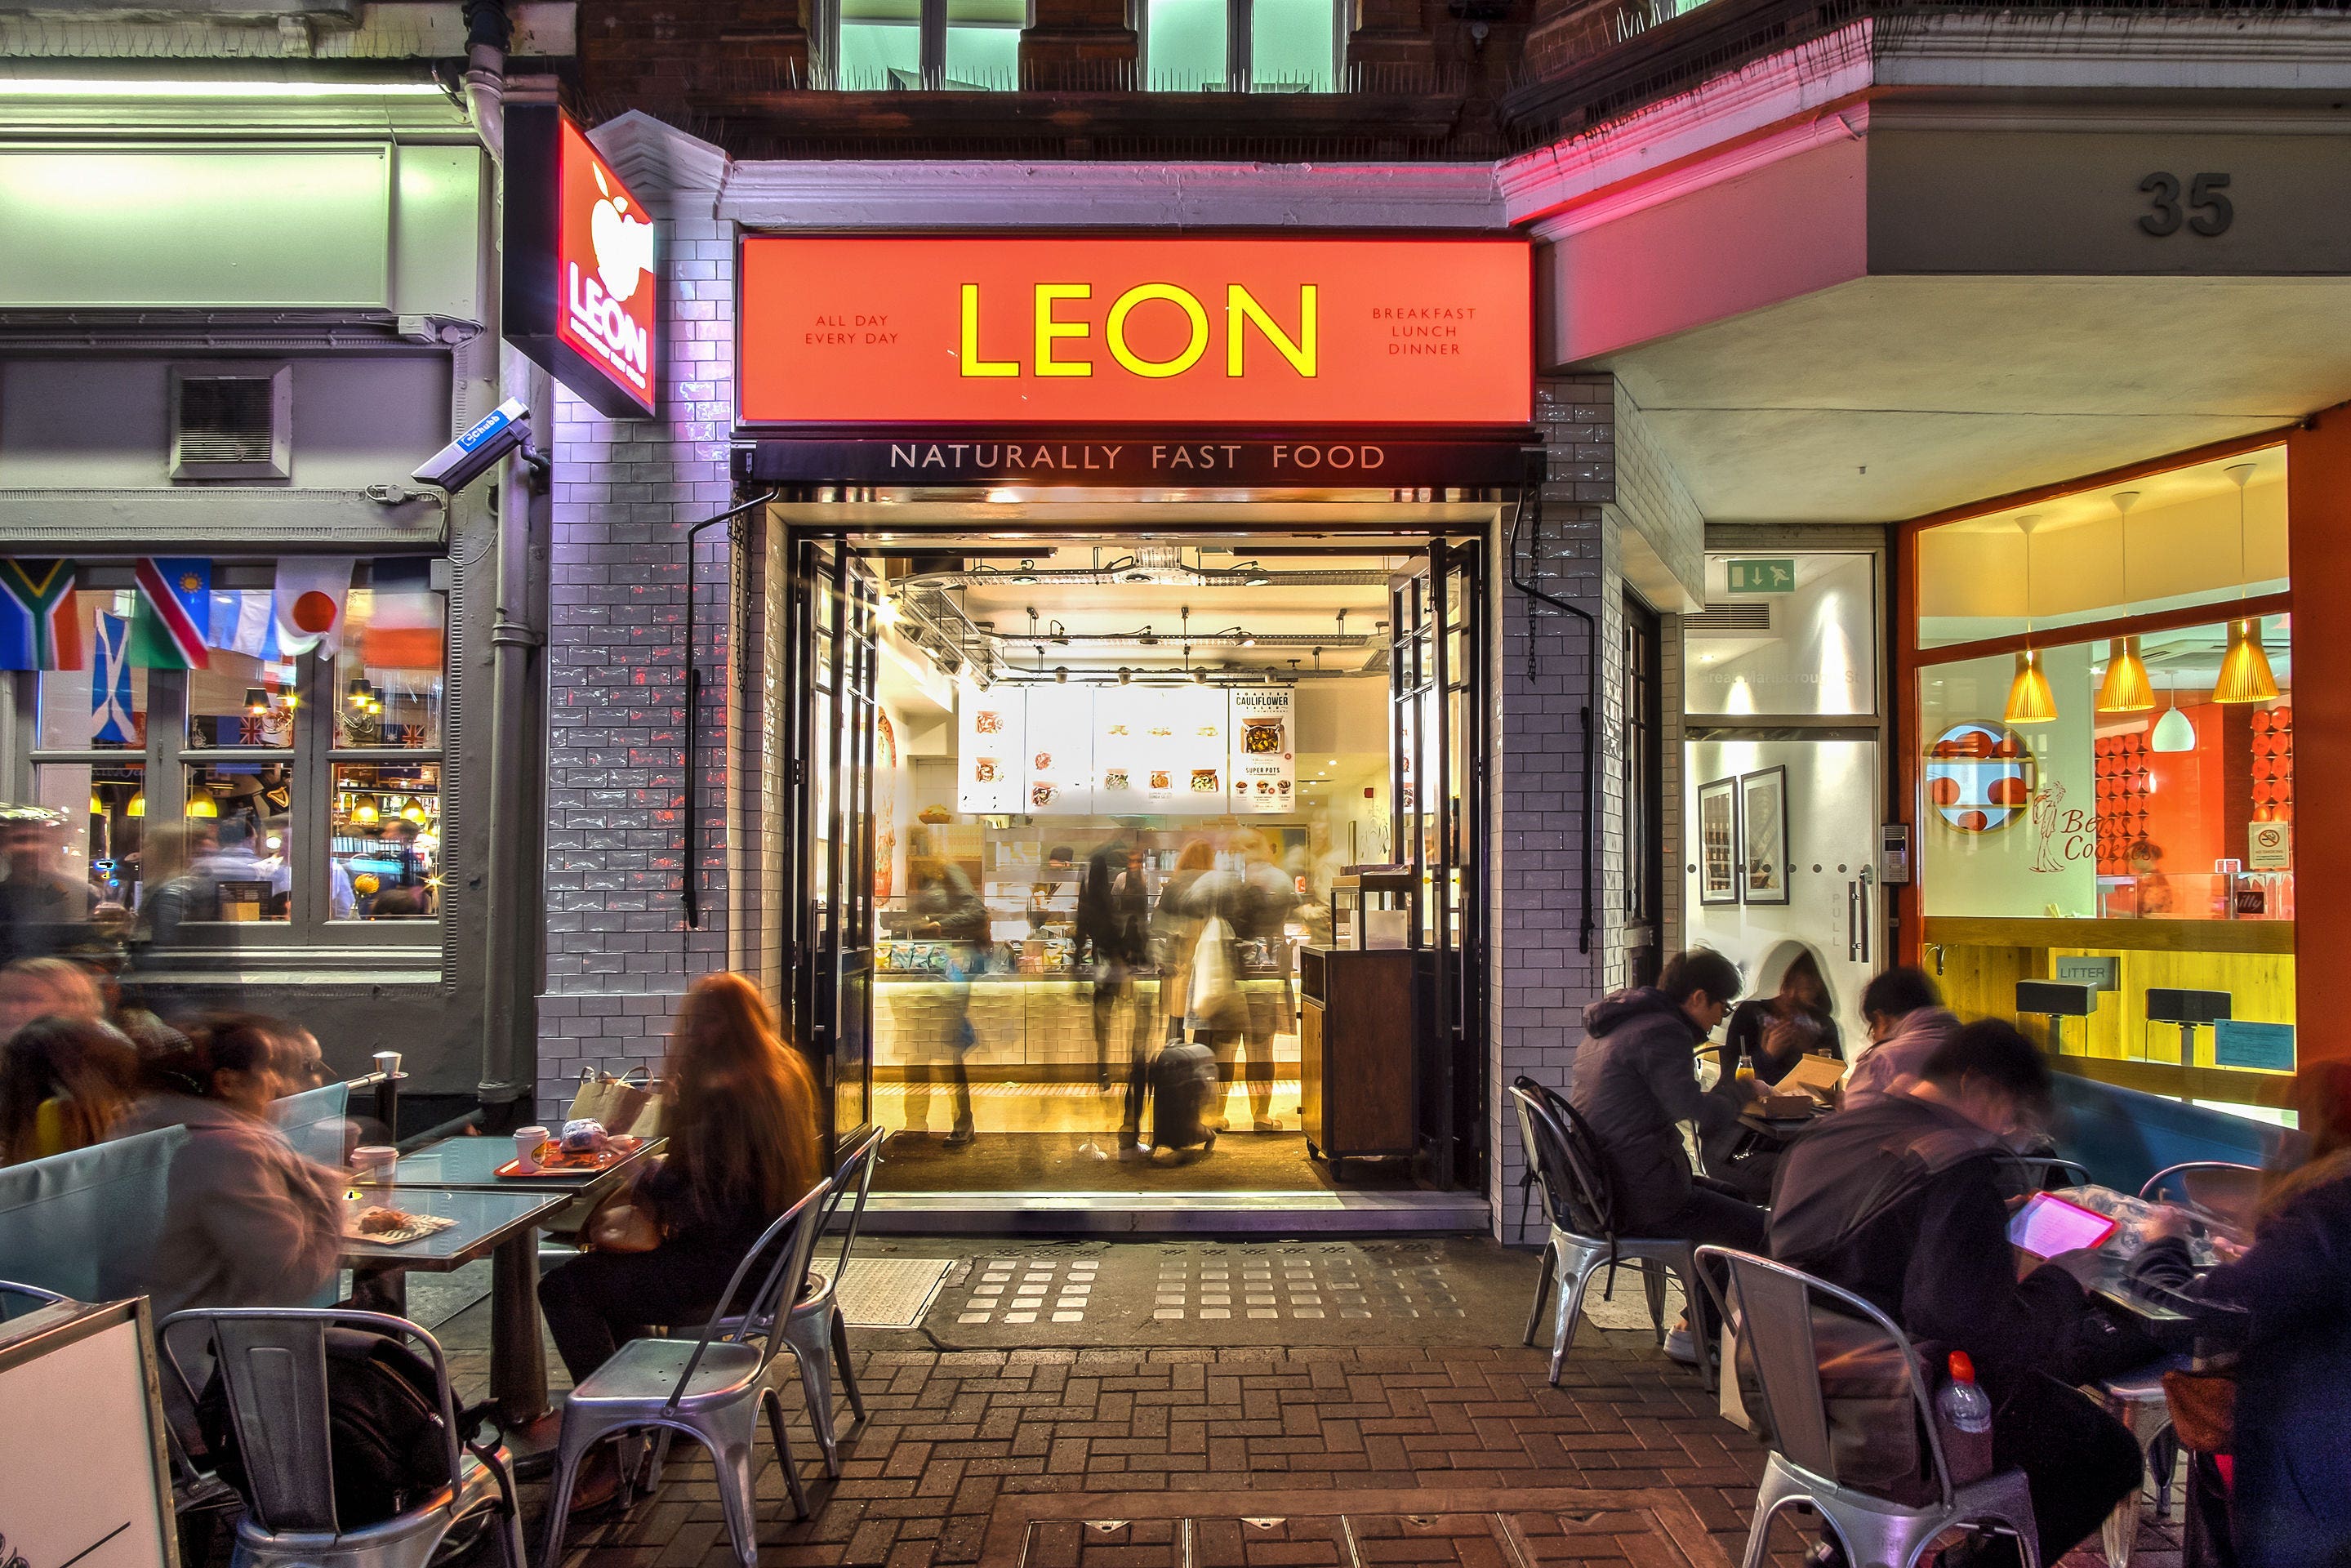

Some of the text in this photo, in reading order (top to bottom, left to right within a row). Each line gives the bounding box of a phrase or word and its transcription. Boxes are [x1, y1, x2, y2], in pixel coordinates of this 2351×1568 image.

[2137, 171, 2233, 238] 35
[569, 261, 647, 374] LEON
[816, 314, 888, 327] ALL DAY
[1372, 307, 1476, 319] BREAKFAST
[960, 282, 1319, 379] LEON
[1392, 326, 1456, 337] LUNCH
[805, 332, 898, 345] EVERY DAY
[1388, 343, 1460, 355] DINNER
[471, 415, 501, 439] Chubb
[891, 443, 1385, 470] NATURALLY FAST FOOD
[1236, 696, 1289, 706] CAULIFLOWER
[2239, 894, 2262, 911] illy
[1832, 893, 1841, 947] PULL
[2060, 967, 2105, 978] LITTER
